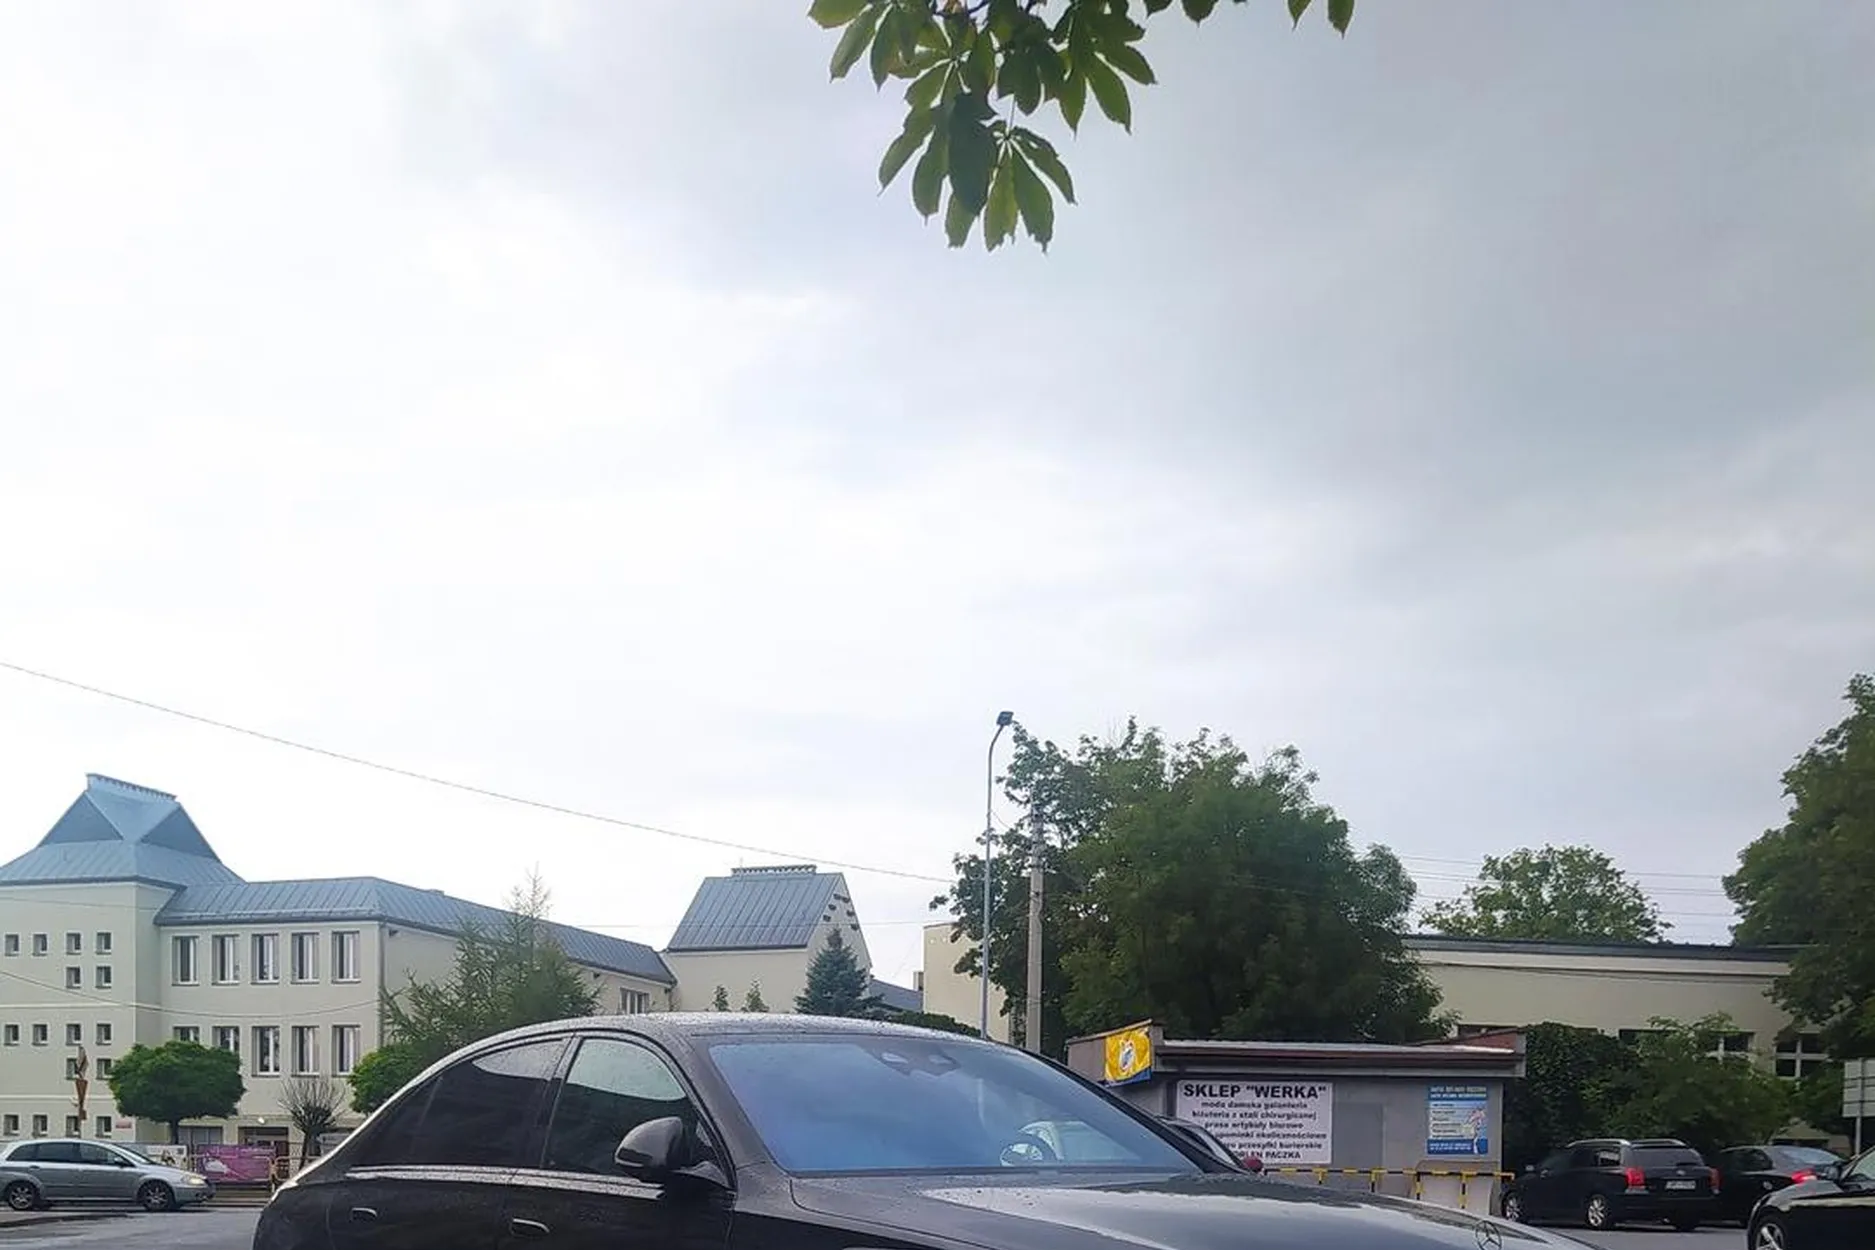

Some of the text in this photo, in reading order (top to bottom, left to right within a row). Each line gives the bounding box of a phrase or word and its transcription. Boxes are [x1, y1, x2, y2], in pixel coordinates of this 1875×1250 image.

[1184, 1084, 1326, 1099] SKLEP "WERKA"
[1201, 1101, 1308, 1111] moda damska galanteria
[1239, 1111, 1258, 1119] stali
[1260, 1111, 1317, 1121] chirurgicznej
[1204, 1122, 1229, 1130] prasa
[1279, 1141, 1322, 1150] kurierskie
[1265, 1151, 1301, 1159] PACZKA
